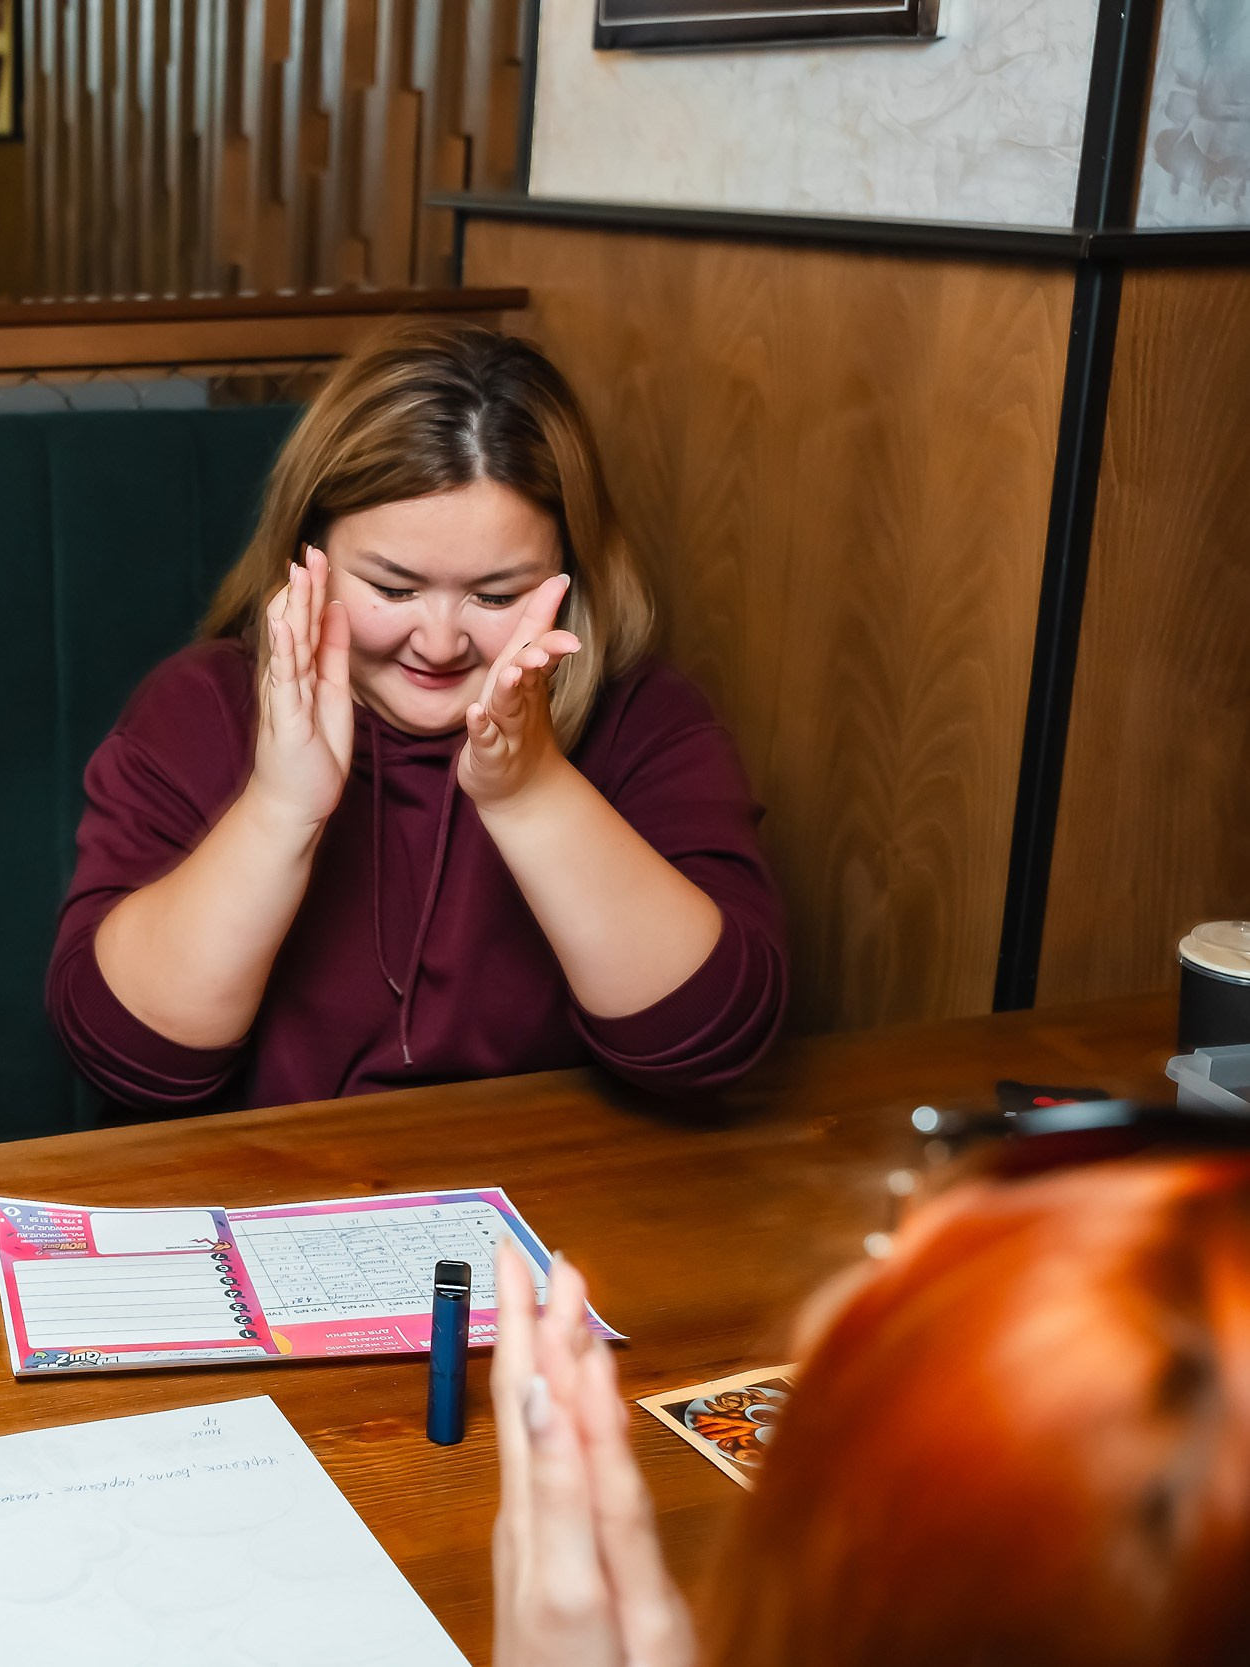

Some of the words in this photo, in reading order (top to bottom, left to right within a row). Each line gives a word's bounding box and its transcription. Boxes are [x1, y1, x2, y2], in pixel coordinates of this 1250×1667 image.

[59, 1242, 87, 1250] WOW
[348, 1335, 394, 1343] КОМАНД
[325, 1342, 381, 1350] ЖЕЛАНИЮ
[55, 1350, 101, 1364] QUIZ
